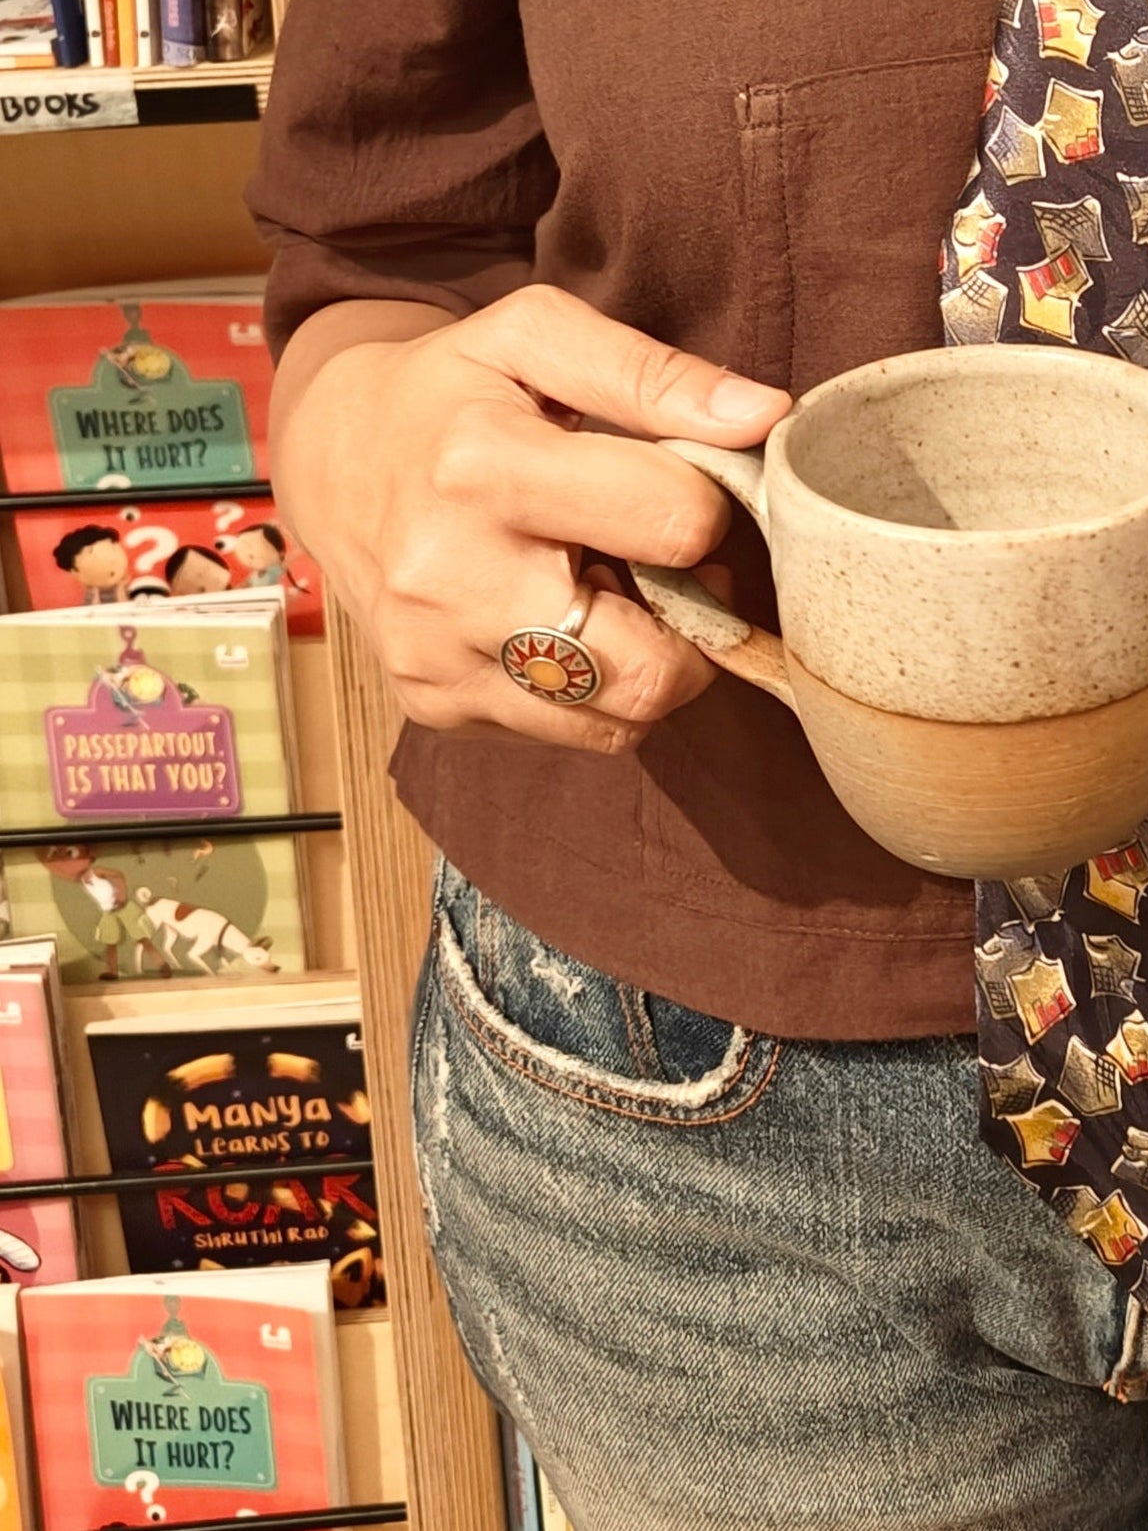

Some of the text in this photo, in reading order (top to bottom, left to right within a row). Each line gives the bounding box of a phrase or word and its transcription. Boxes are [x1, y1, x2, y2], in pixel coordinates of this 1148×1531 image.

[0, 92, 101, 122] BOOKS
[76, 403, 225, 440] WHERE DOES
[101, 436, 208, 470] IT HURT?
[66, 761, 228, 794] IS THAT YOU?
[299, 1131, 331, 1149] TO
[110, 1399, 252, 1435] WHERE DOES
[133, 1436, 235, 1471] IT HURT?
